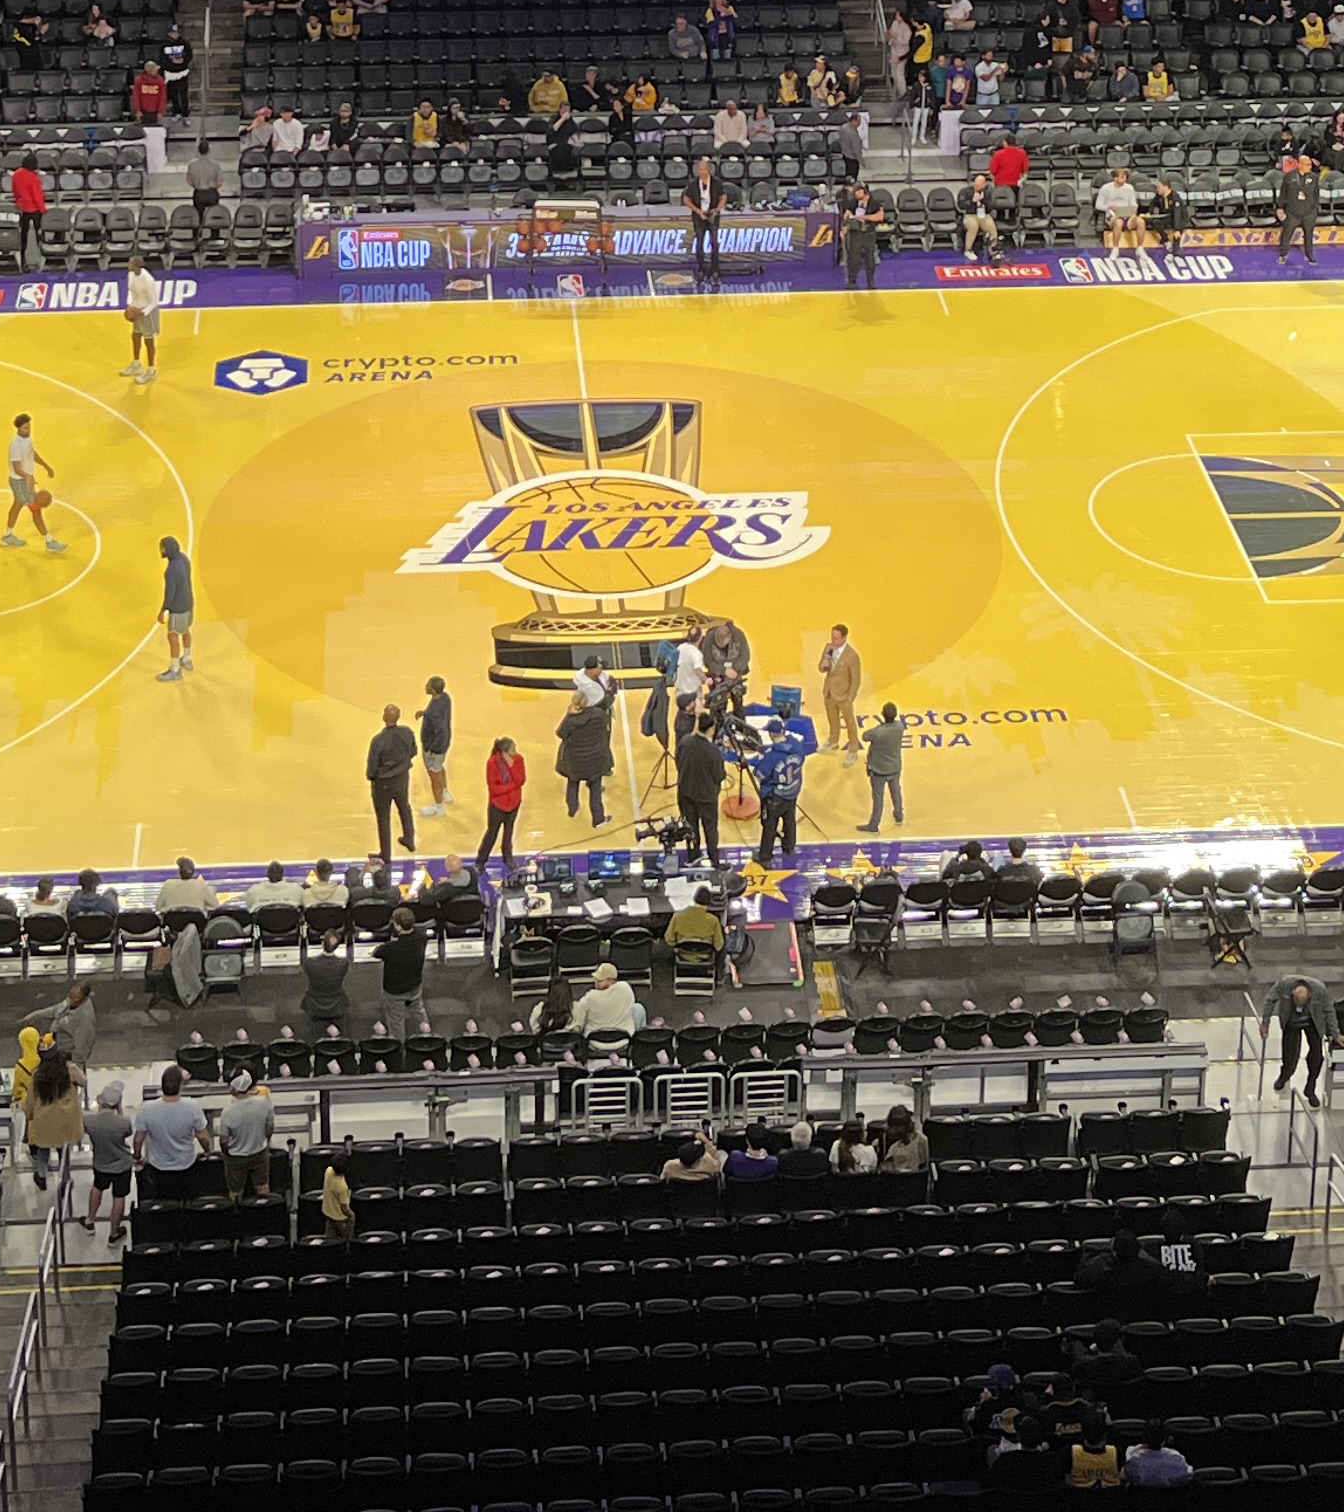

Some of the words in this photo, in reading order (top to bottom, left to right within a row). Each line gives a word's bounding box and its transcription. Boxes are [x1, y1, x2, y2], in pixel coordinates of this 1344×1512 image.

[361, 240, 395, 268] NBA
[397, 240, 432, 269] CUP
[944, 265, 1043, 279] Emirates
[1091, 256, 1167, 287] NBA
[1167, 255, 1234, 285] CUP
[49, 282, 120, 309] NBA
[322, 351, 519, 370] crypto.com
[324, 369, 435, 384] ARENA
[543, 502, 610, 514] LOS
[618, 497, 793, 512] ANGELES
[419, 505, 813, 566] LAKERS
[745, 874, 769, 887] 87
[1160, 1244, 1192, 1267] BITE
